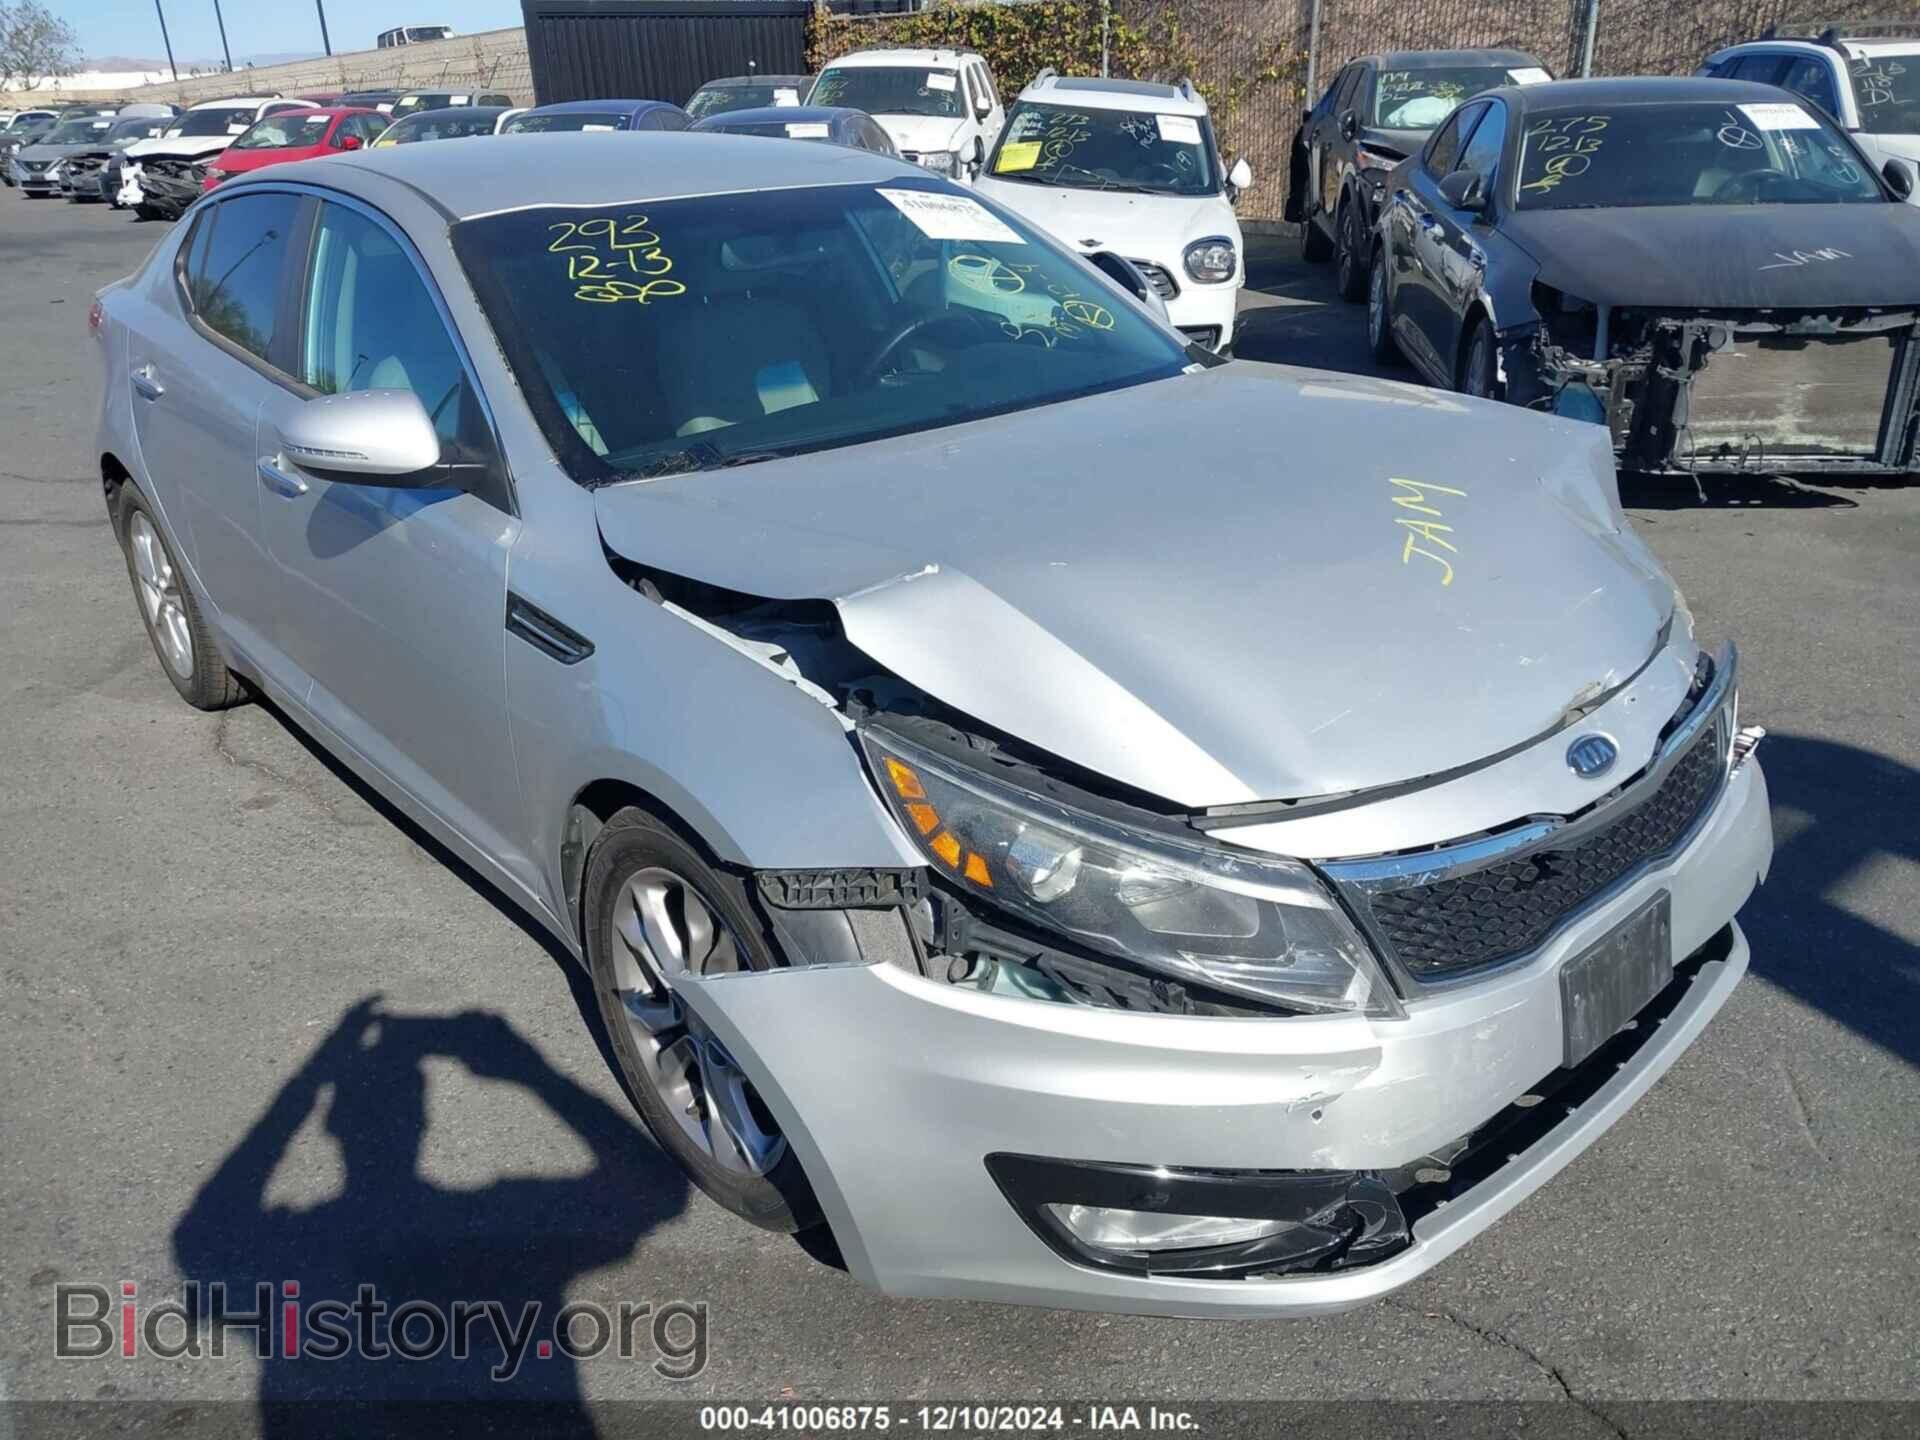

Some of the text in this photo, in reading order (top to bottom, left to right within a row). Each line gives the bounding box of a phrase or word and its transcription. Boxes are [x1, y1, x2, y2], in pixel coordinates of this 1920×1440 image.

[1527, 116, 1612, 136] 275
[548, 215, 661, 251] 293
[568, 247, 673, 280] 12-13
[1388, 477, 1468, 587] JAM
